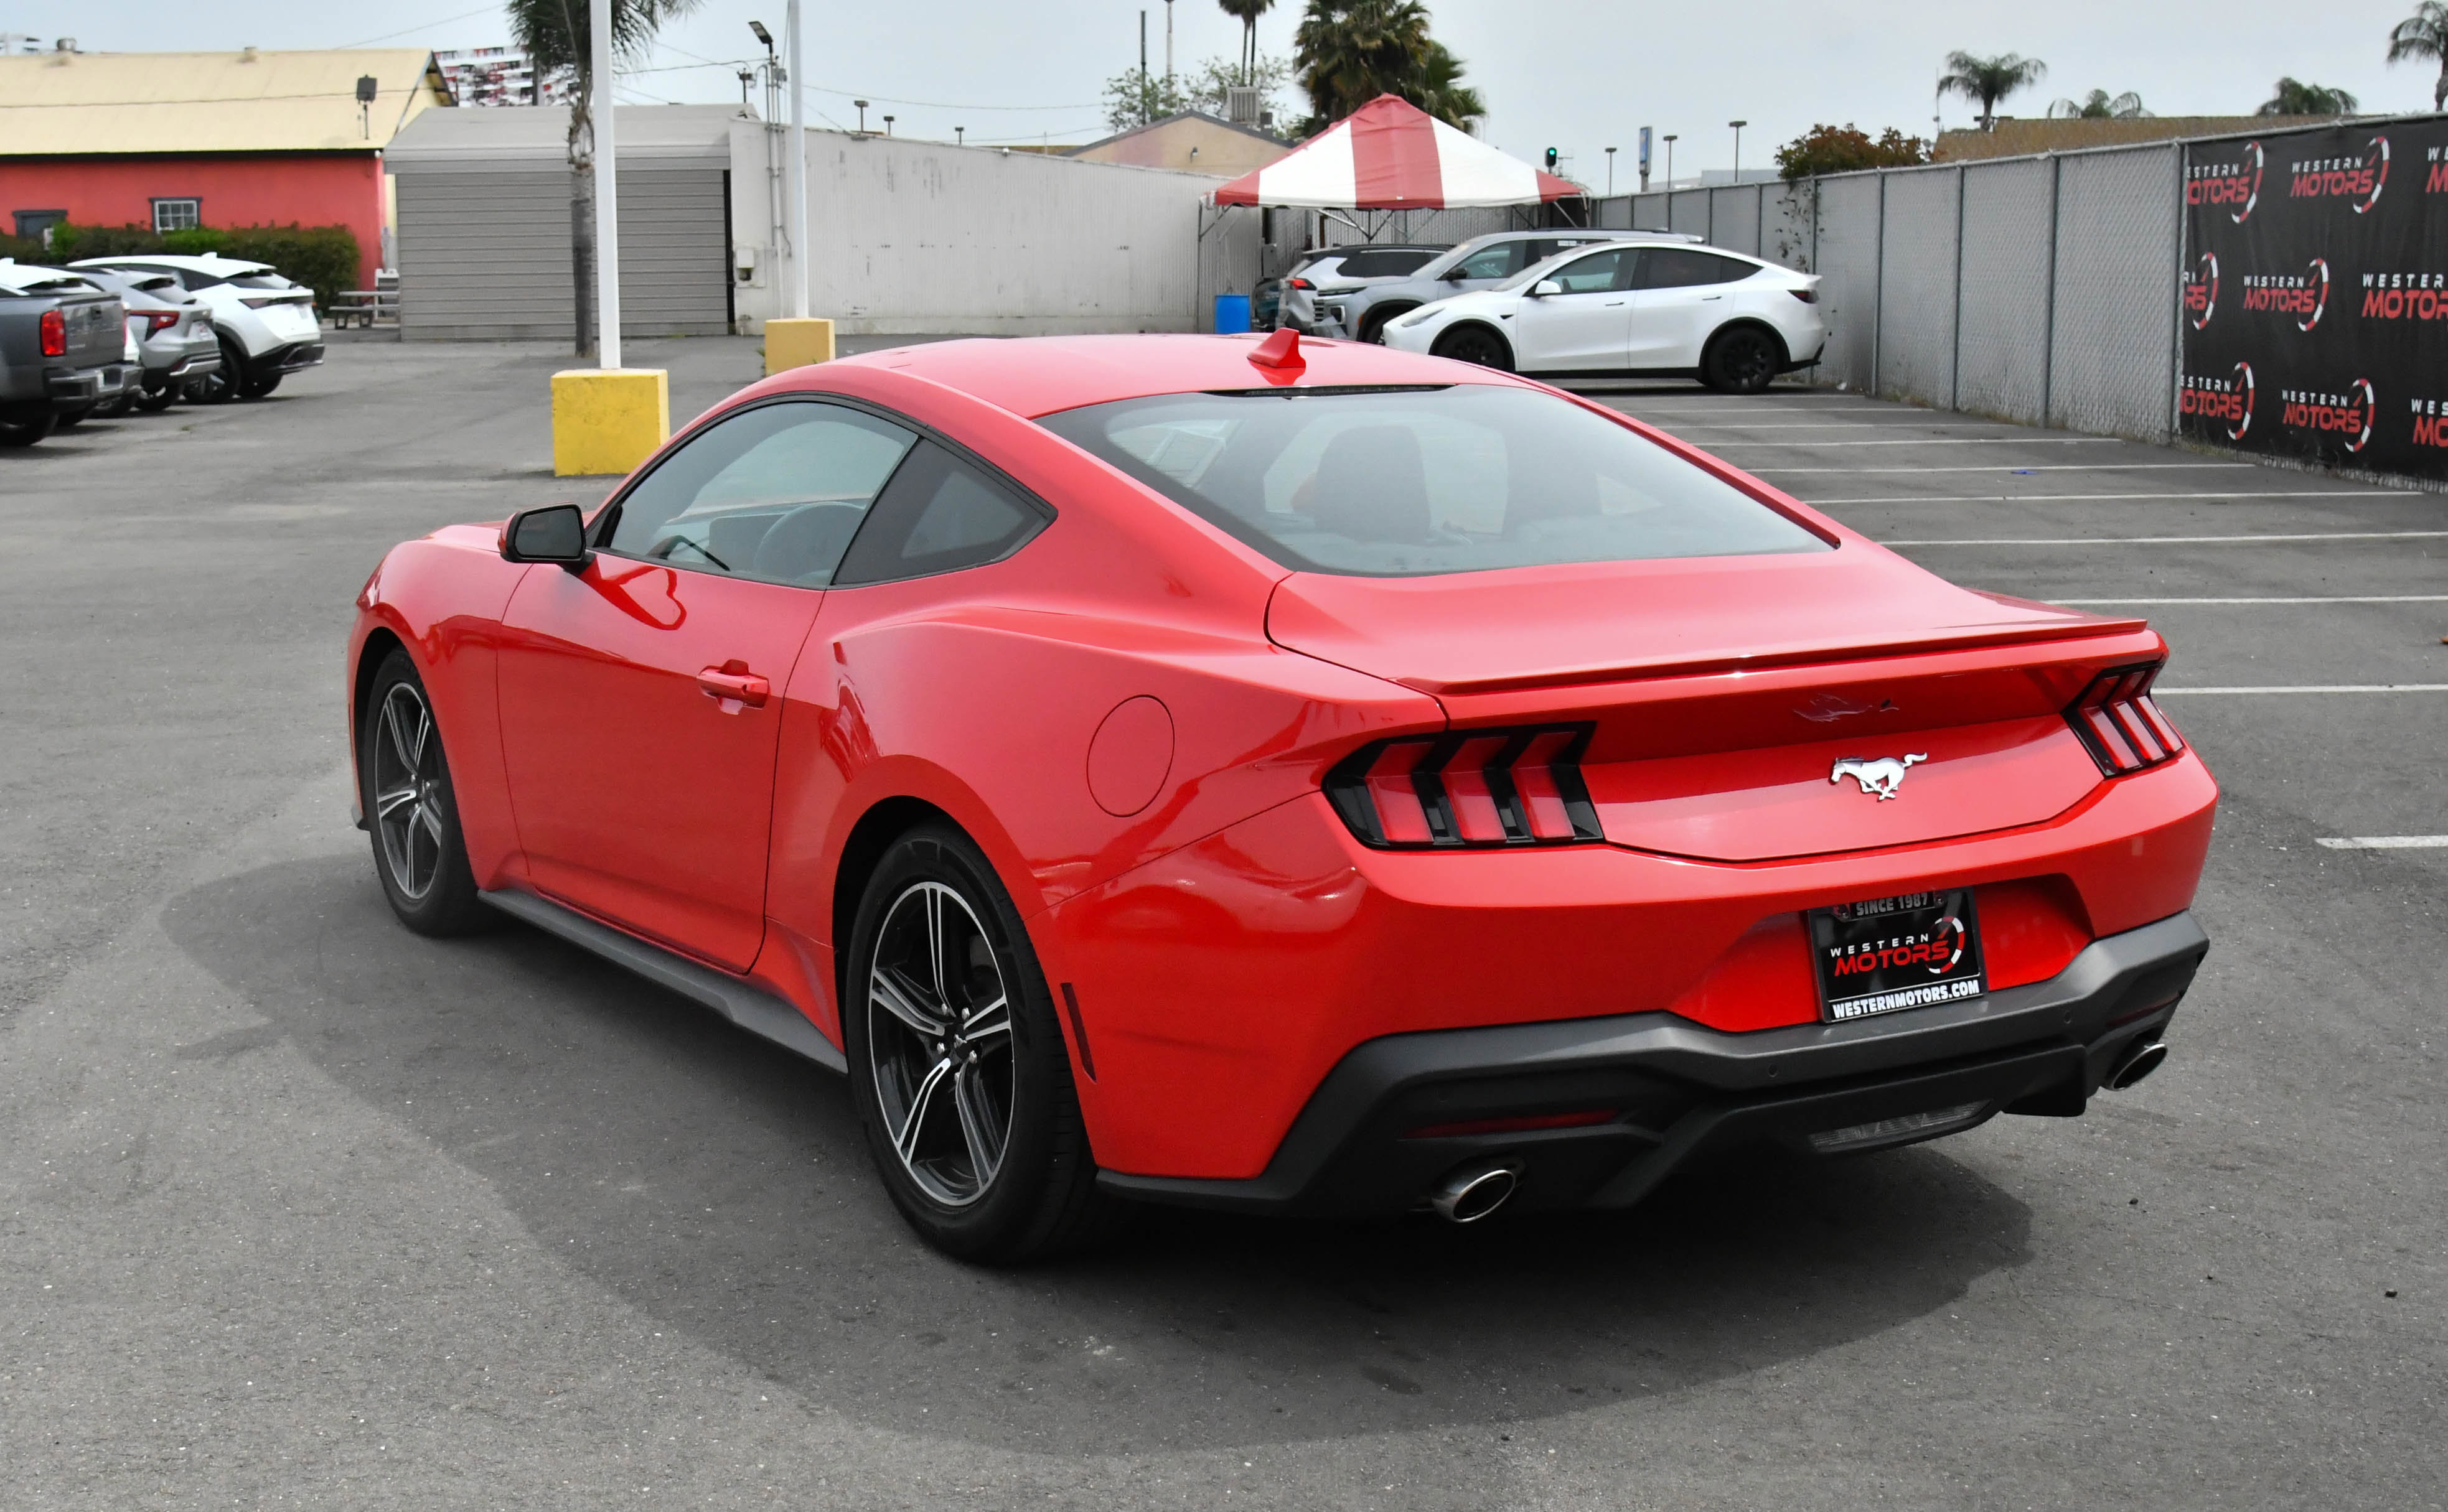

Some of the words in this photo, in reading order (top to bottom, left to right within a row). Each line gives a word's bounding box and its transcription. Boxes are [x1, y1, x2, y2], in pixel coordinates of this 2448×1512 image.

[2187, 163, 2239, 179] ESTERN
[2292, 156, 2362, 173] WESTERN
[2187, 175, 2251, 205] OTORS
[2291, 169, 2375, 197] MOTORS
[2243, 275, 2304, 287] WESTERN
[2363, 273, 2444, 288] WESTER
[2244, 287, 2315, 312] MOTORS
[2361, 289, 2448, 320] MOTOR
[2180, 375, 2231, 392] ESTERN
[2180, 388, 2243, 420] OTORS
[2282, 389, 2347, 407] WESTERN
[2282, 402, 2361, 433] MOTORS
[1856, 897, 1895, 917] SINCE
[1898, 892, 1928, 909] 1987
[1831, 933, 1929, 957] WESTERN
[1834, 940, 1950, 976] MOTORS
[1832, 979, 1980, 1019] WESTERNMOTORS.COM
